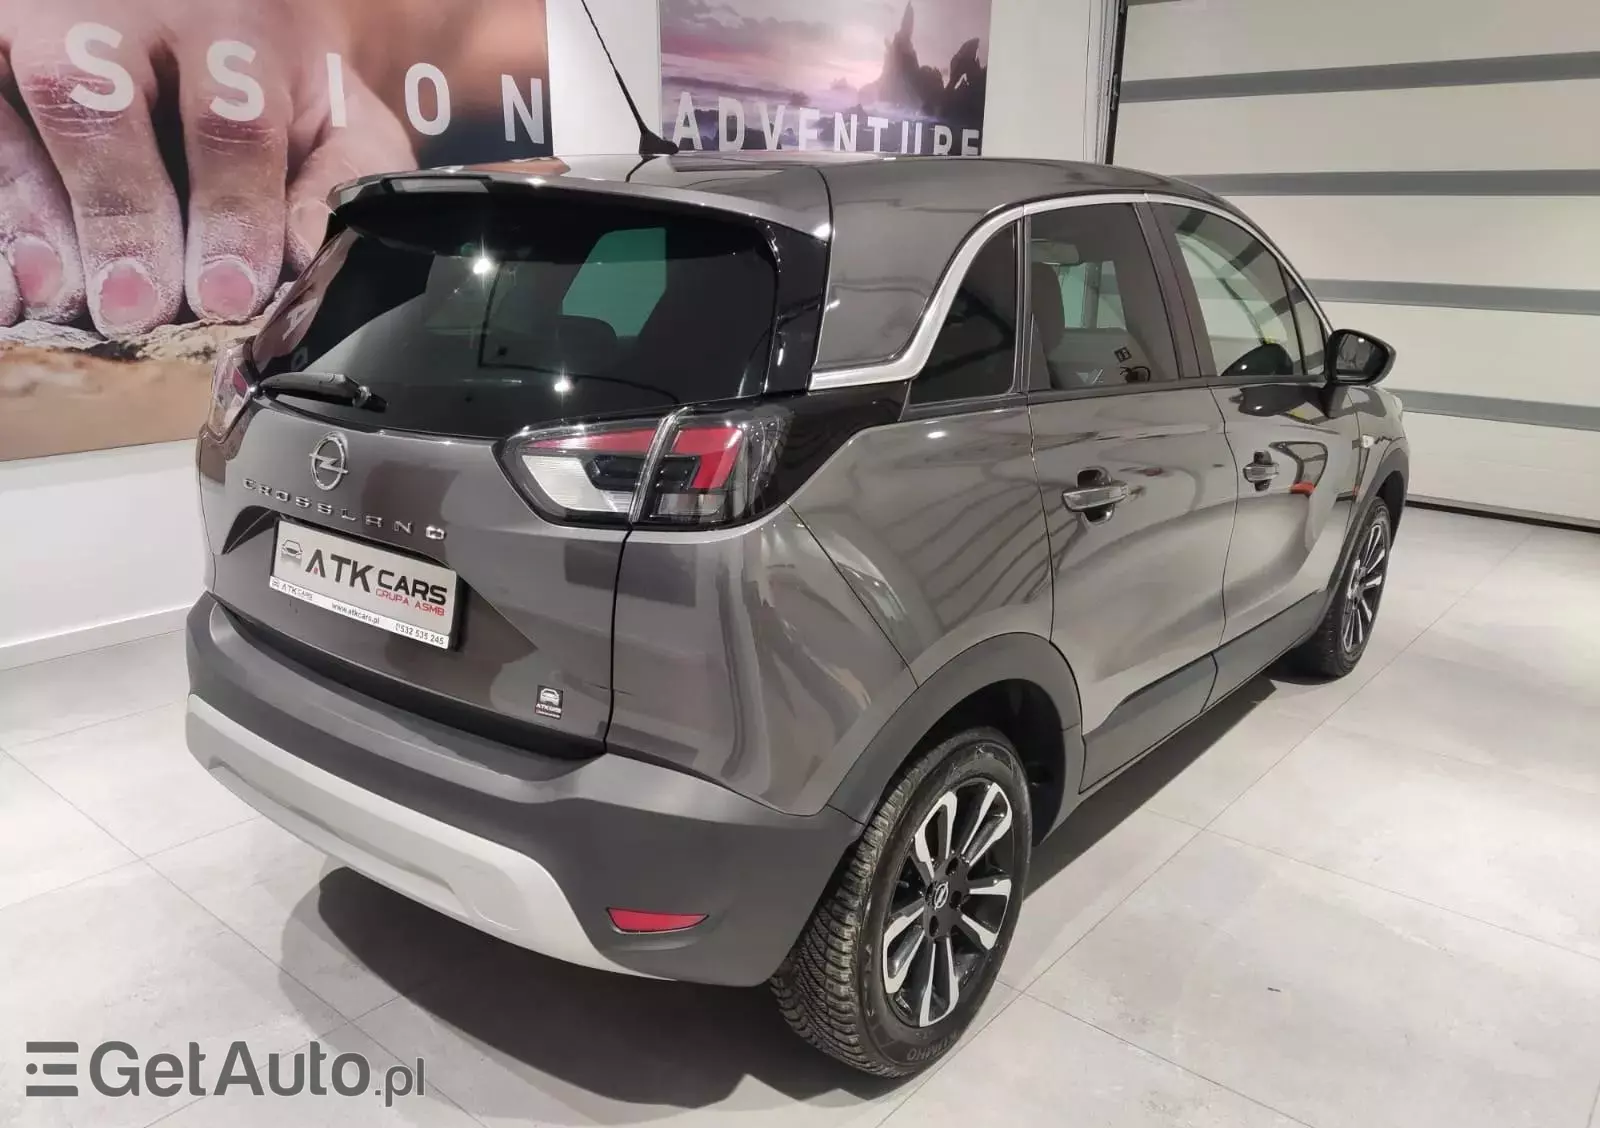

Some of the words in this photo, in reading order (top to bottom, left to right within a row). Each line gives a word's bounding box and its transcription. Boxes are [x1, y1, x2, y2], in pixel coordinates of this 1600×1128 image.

[243, 478, 446, 540] CROSSLAND
[305, 549, 375, 593] ATK
[377, 569, 448, 606] CARS
[331, 602, 380, 624] www.atkcars.pl
[376, 589, 409, 607] GRUPA
[414, 600, 445, 616] ASMB
